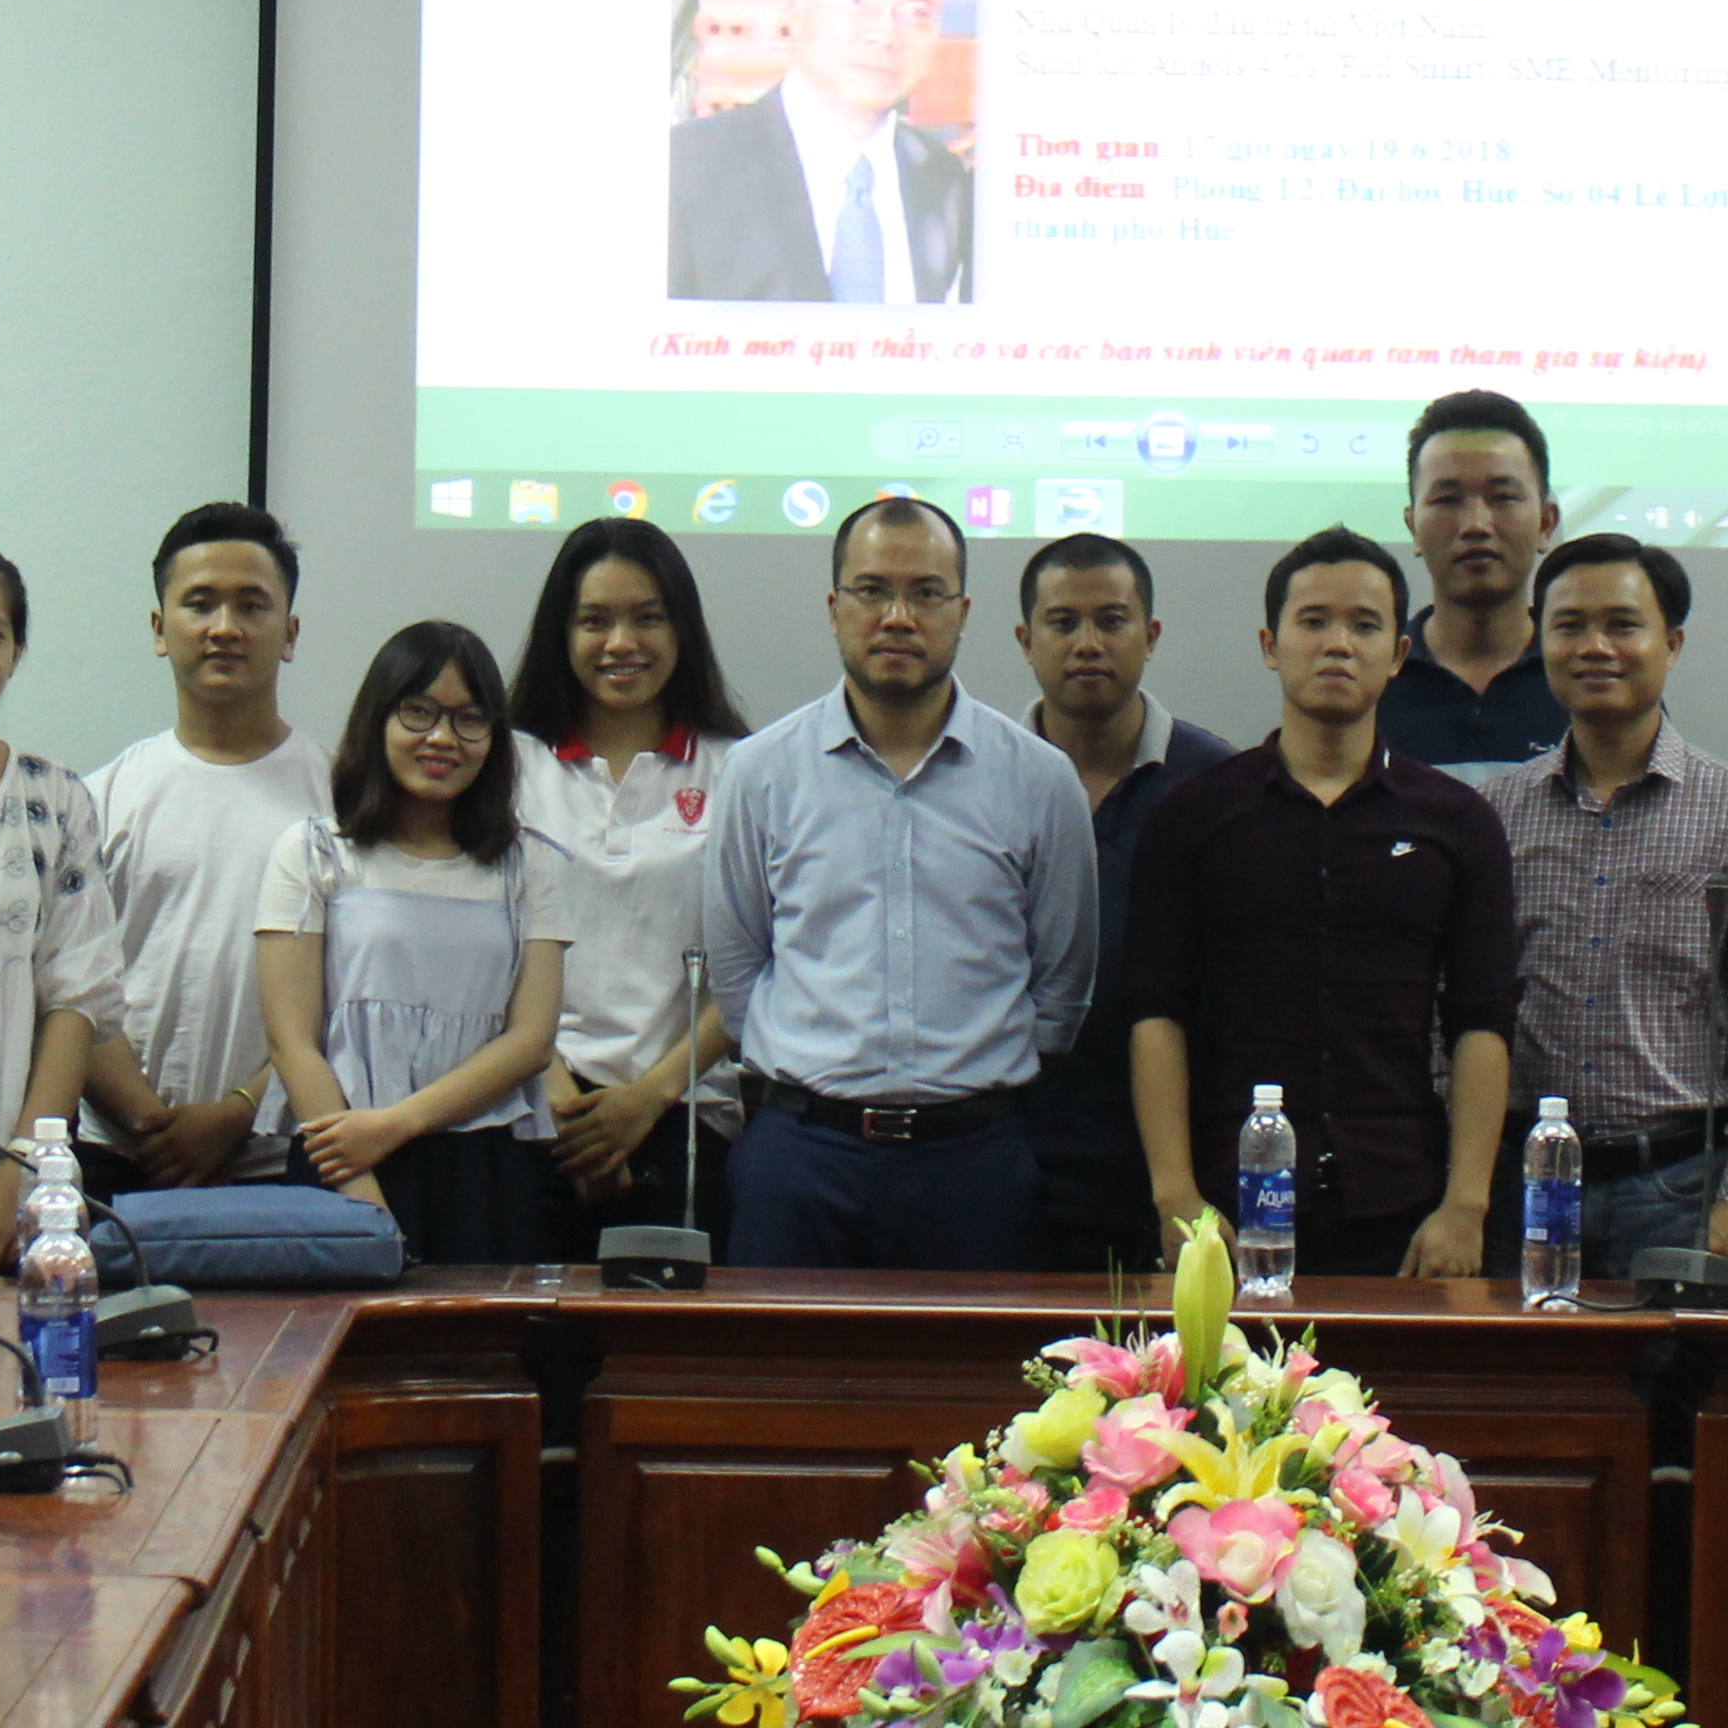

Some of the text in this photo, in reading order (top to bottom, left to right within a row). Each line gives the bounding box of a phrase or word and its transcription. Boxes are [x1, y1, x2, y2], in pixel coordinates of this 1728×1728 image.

[1164, 342, 1224, 363] sinh
[1302, 348, 1375, 372] quan
[1450, 345, 1524, 367] tham
[1532, 349, 1581, 376] gia
